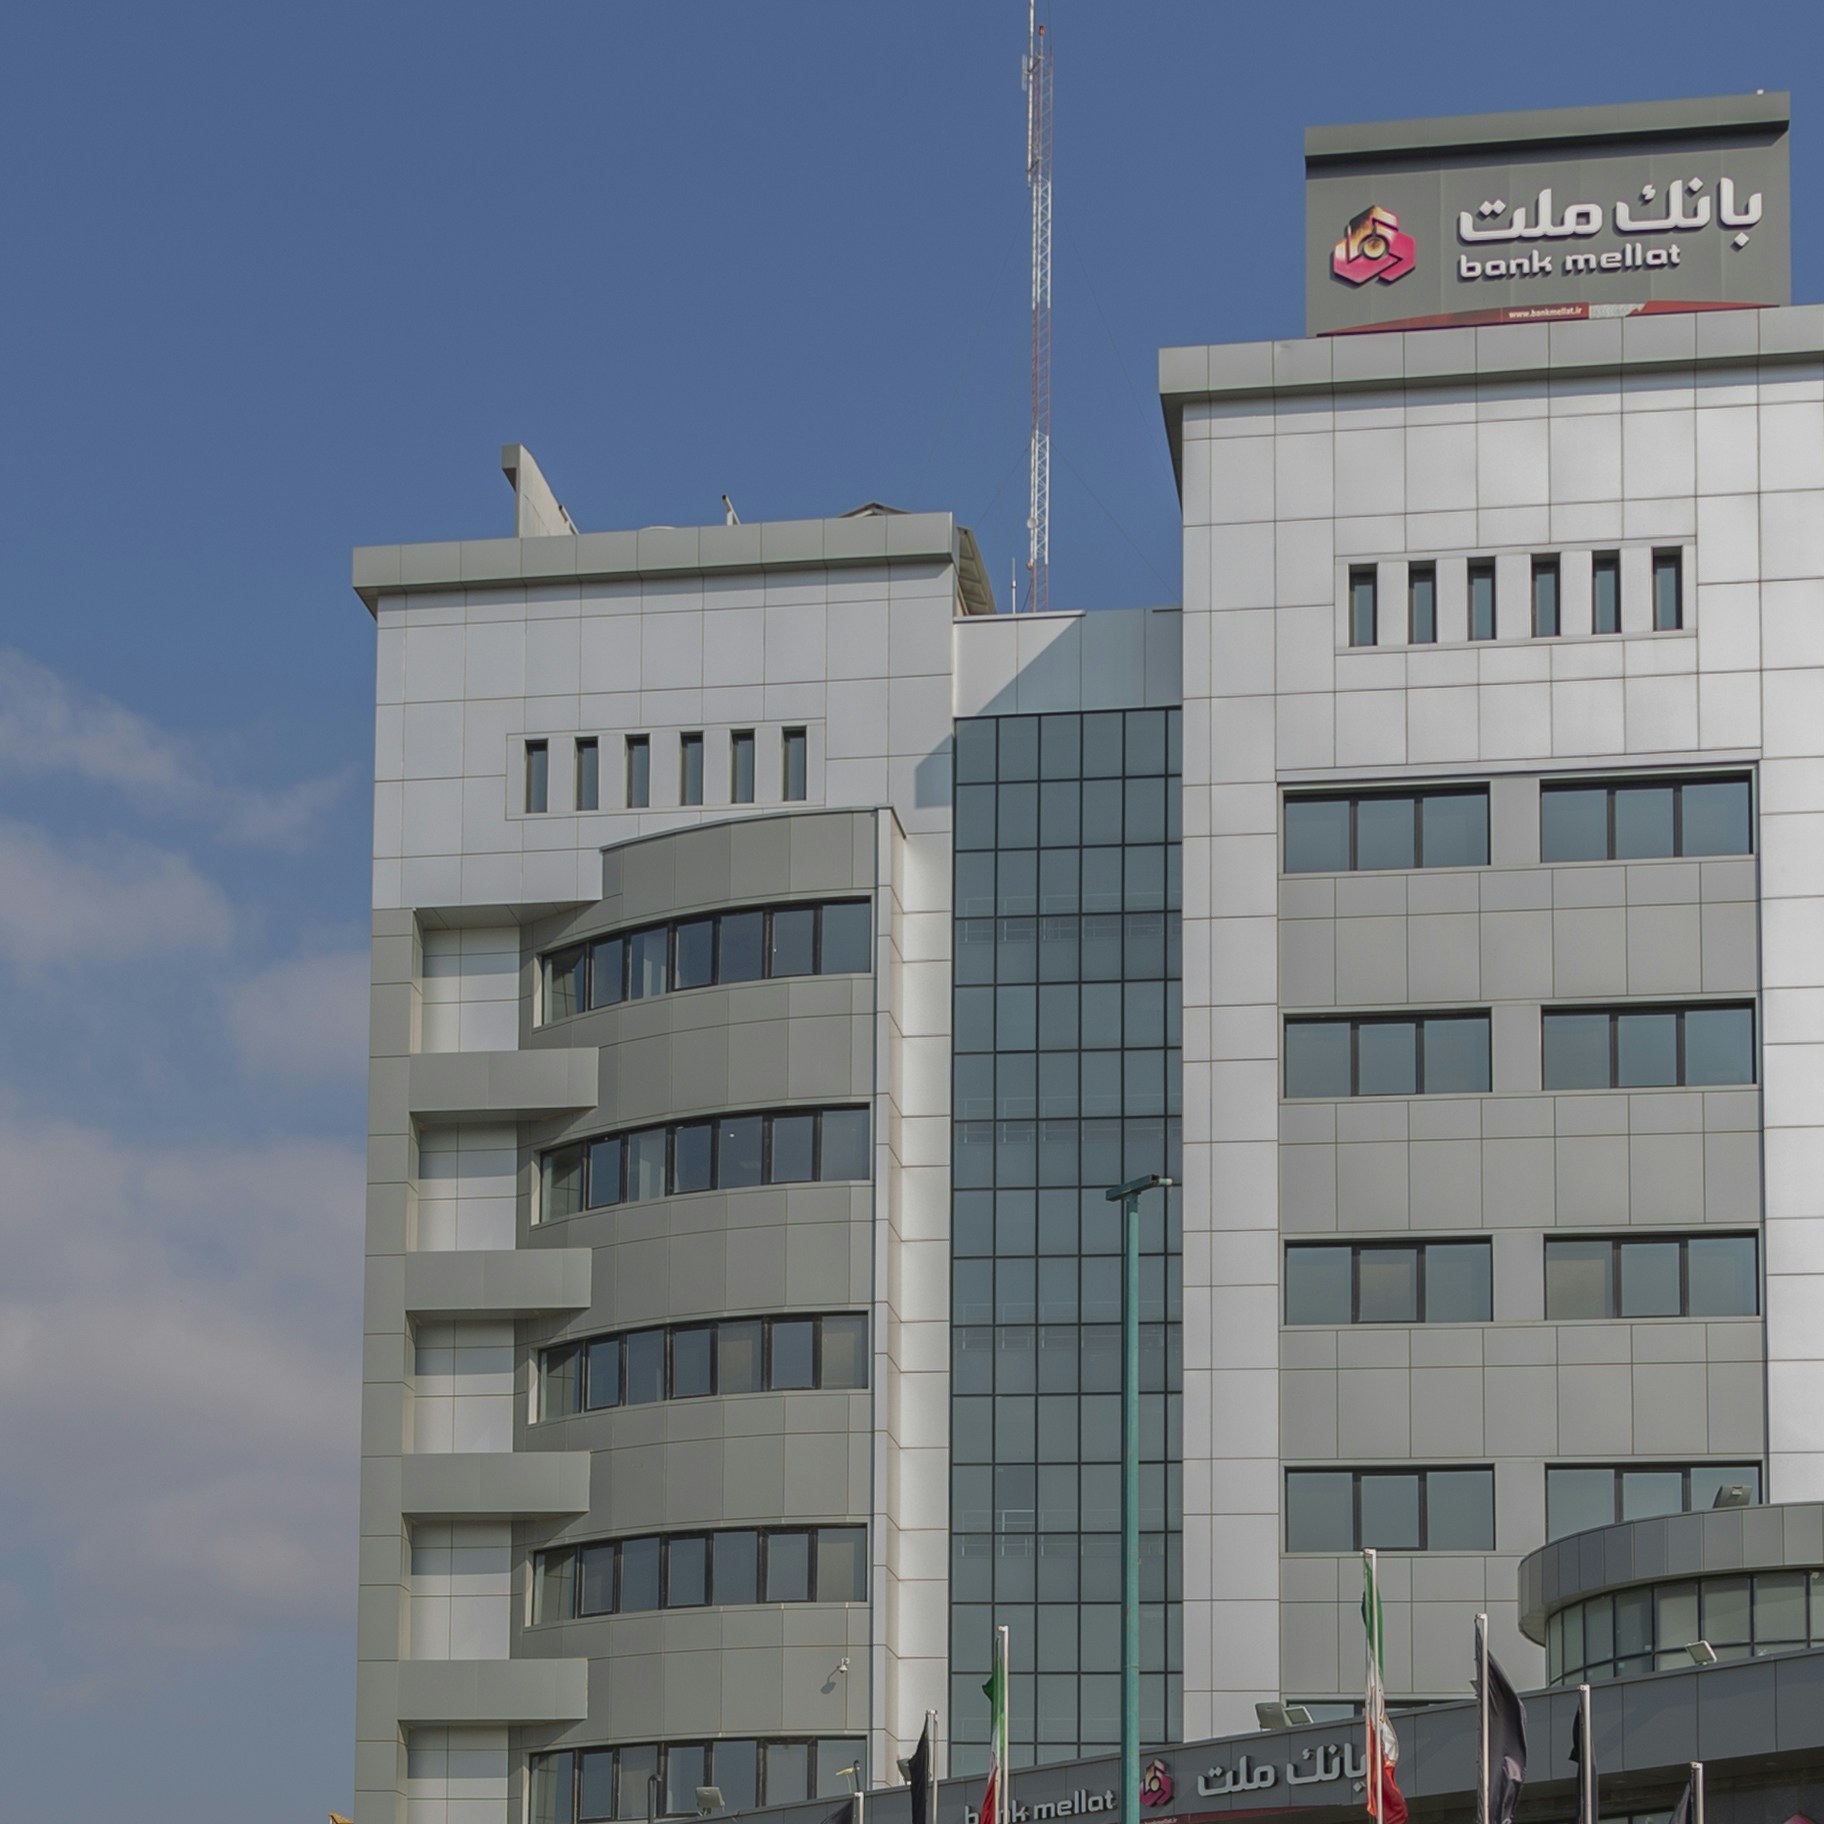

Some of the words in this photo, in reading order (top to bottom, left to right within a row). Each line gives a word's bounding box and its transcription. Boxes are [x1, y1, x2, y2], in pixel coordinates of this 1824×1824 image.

[1459, 187, 1603, 242] ملت
[1459, 249, 1553, 279] bank
[1565, 243, 1681, 271] mellat
[1198, 1755, 1275, 1797] ملت
[1033, 1788, 1114, 1820] mellat
